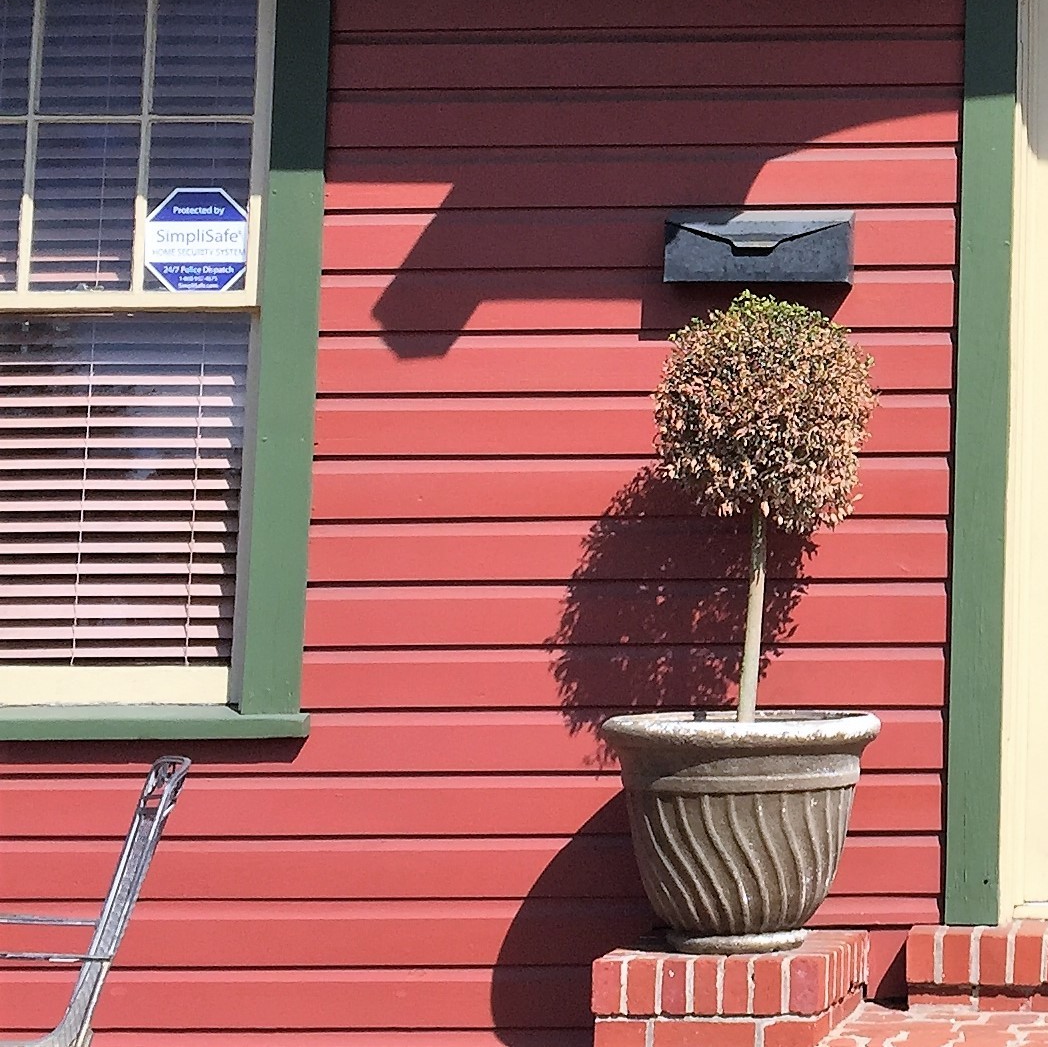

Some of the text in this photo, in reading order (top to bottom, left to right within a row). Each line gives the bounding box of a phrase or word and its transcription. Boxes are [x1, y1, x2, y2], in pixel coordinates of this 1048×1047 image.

[172, 206, 226, 216] Protected by
[152, 248, 175, 256] HOME
[177, 248, 214, 256] SECURITY
[163, 265, 235, 275] 24/7 Police Dispatch
